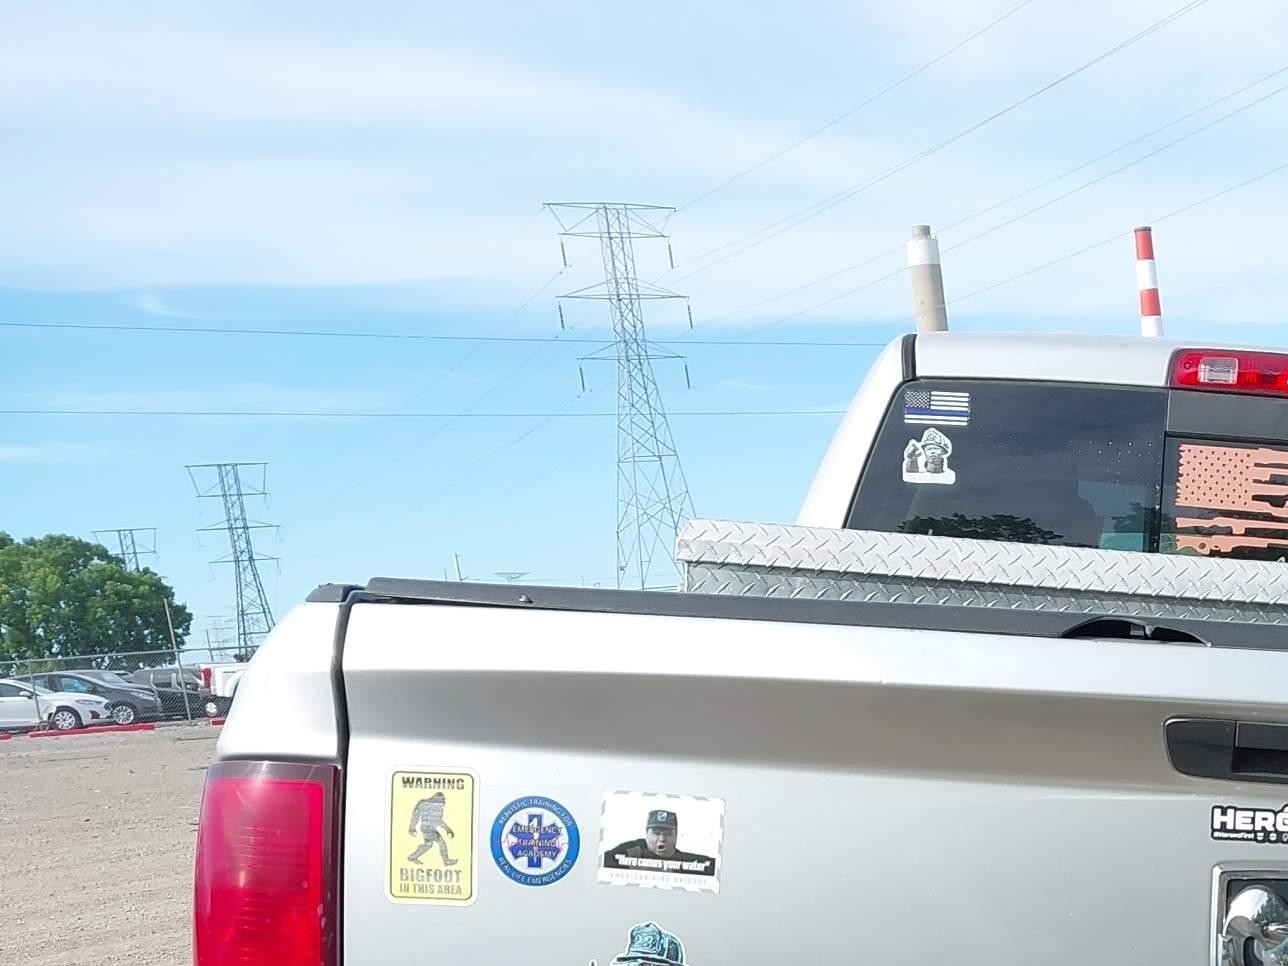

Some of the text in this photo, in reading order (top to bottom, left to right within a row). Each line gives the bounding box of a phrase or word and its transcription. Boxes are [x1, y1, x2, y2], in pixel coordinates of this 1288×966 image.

[402, 776, 465, 790] WARNING
[512, 825, 563, 833] EMERGENCY
[517, 850, 556, 858] ACADEMY
[400, 868, 463, 883] BIGFOOT
[400, 882, 463, 895] IN THIS AREA
